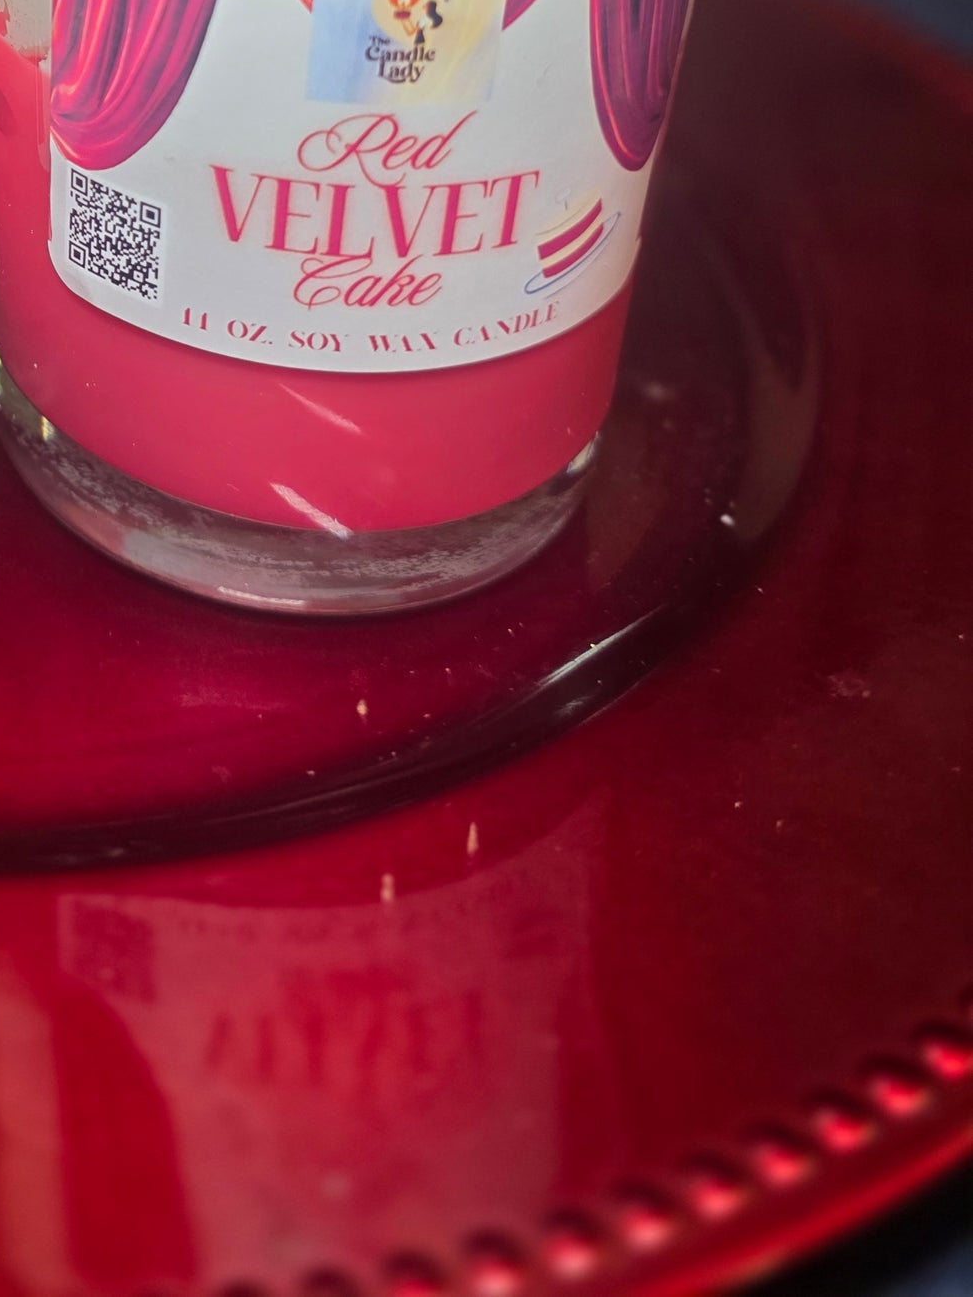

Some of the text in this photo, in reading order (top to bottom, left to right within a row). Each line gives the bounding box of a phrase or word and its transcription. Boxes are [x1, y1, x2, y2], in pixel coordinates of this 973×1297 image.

[365, 46, 436, 62] Candle
[369, 35, 390, 46] The
[378, 61, 425, 84] Lady
[297, 110, 478, 187] Red
[208, 164, 540, 258] VELVET
[293, 253, 443, 310] Cake
[227, 318, 274, 345] OZ.
[288, 330, 349, 352] SOY
[368, 330, 441, 353] WAX
[453, 300, 560, 347] CANDLE
